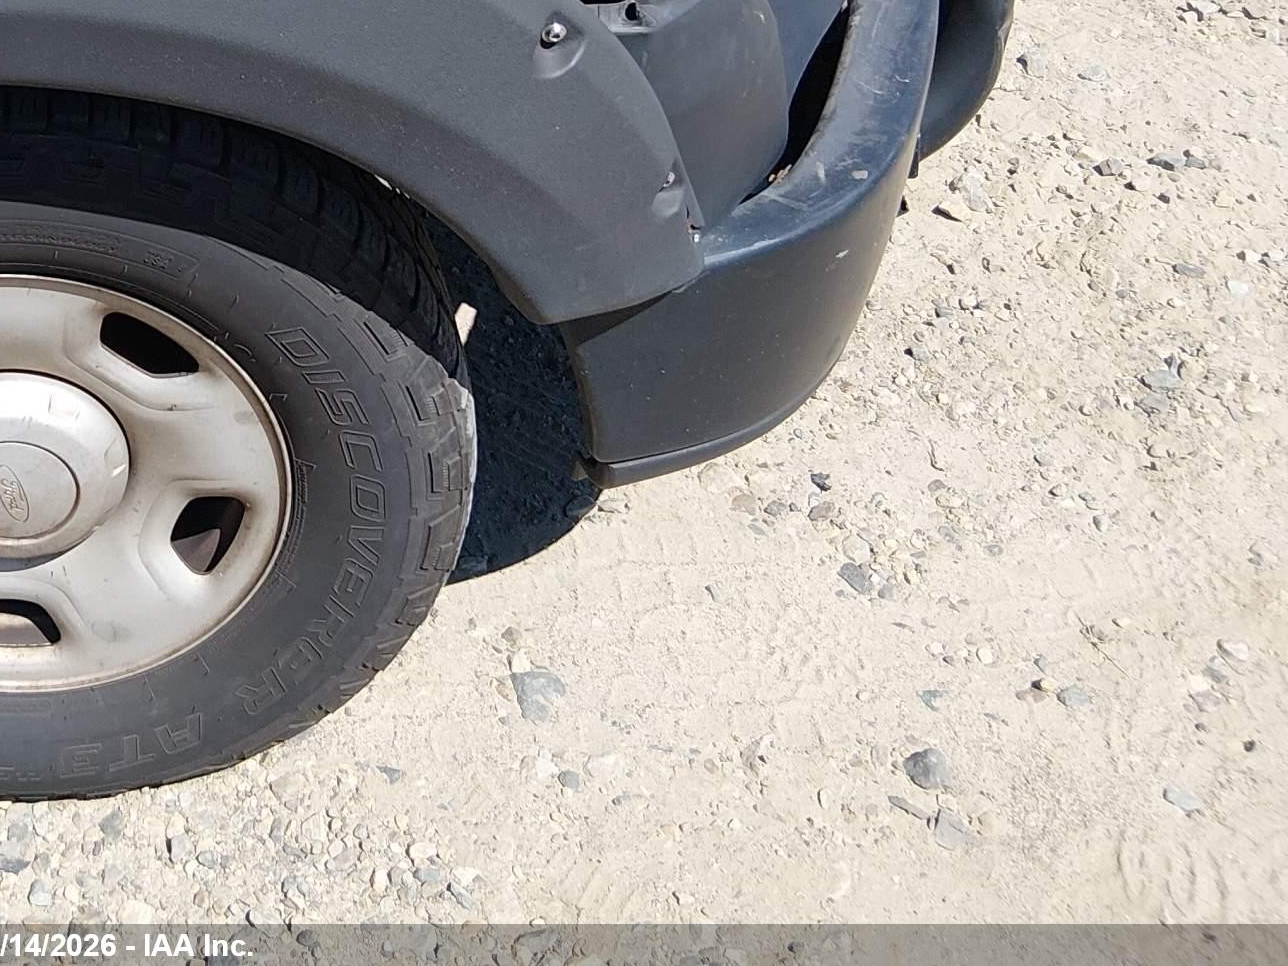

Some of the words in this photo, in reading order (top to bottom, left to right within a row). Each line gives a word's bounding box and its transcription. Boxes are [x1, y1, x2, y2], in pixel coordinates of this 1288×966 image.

[0, 478, 25, 511] Ford
[234, 326, 386, 716] DISCOVERER
[60, 712, 202, 778] AT3
